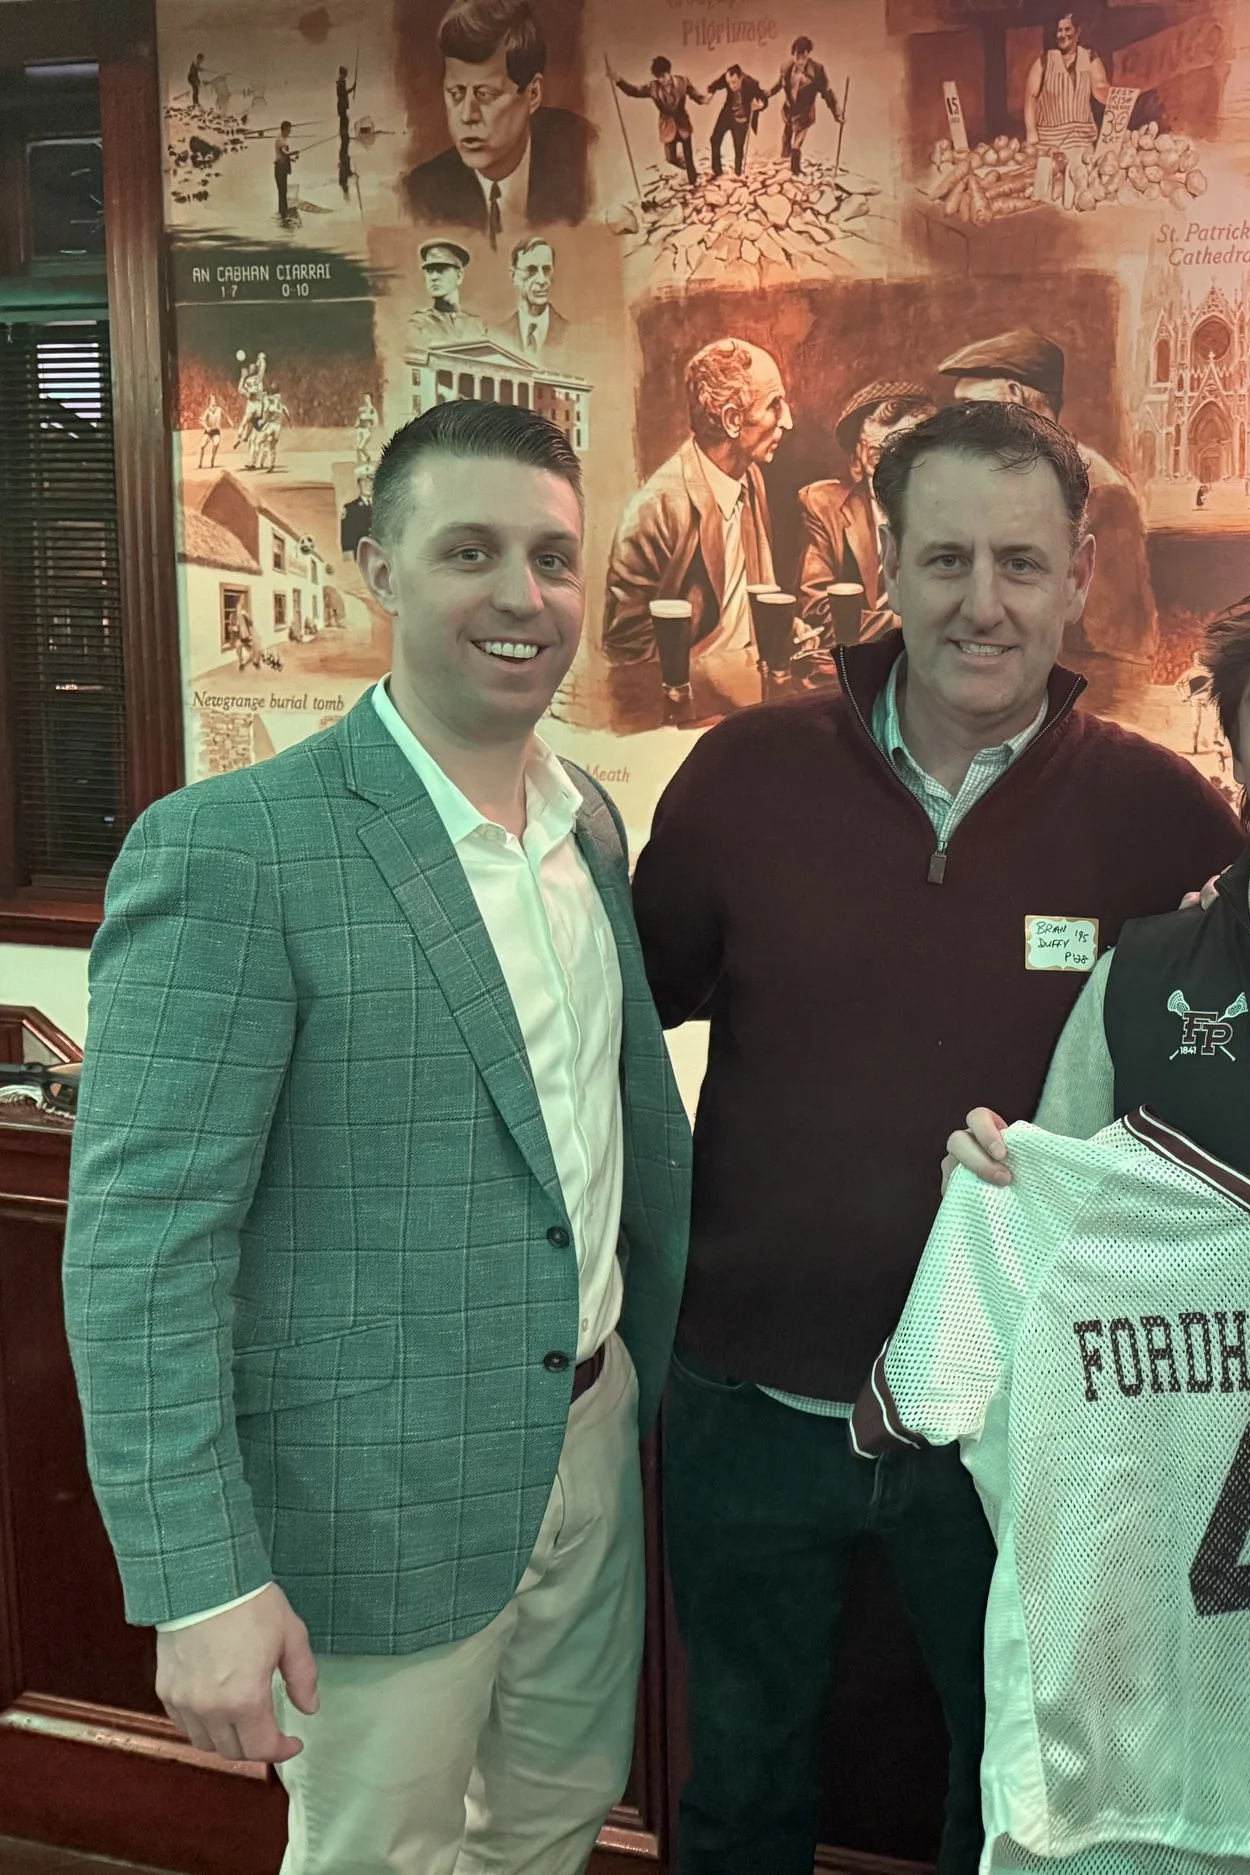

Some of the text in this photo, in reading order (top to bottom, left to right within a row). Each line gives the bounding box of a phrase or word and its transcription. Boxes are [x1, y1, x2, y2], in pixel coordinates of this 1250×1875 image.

[681, 18, 778, 51] Pilgrimage
[1156, 224, 1179, 243] St.
[192, 267, 210, 282] AN
[216, 265, 270, 282] CABHAN
[192, 691, 344, 711] Newgrange burial tomb
[1037, 938, 1070, 949] DUFFY
[1180, 1046, 1197, 1054] 1841
